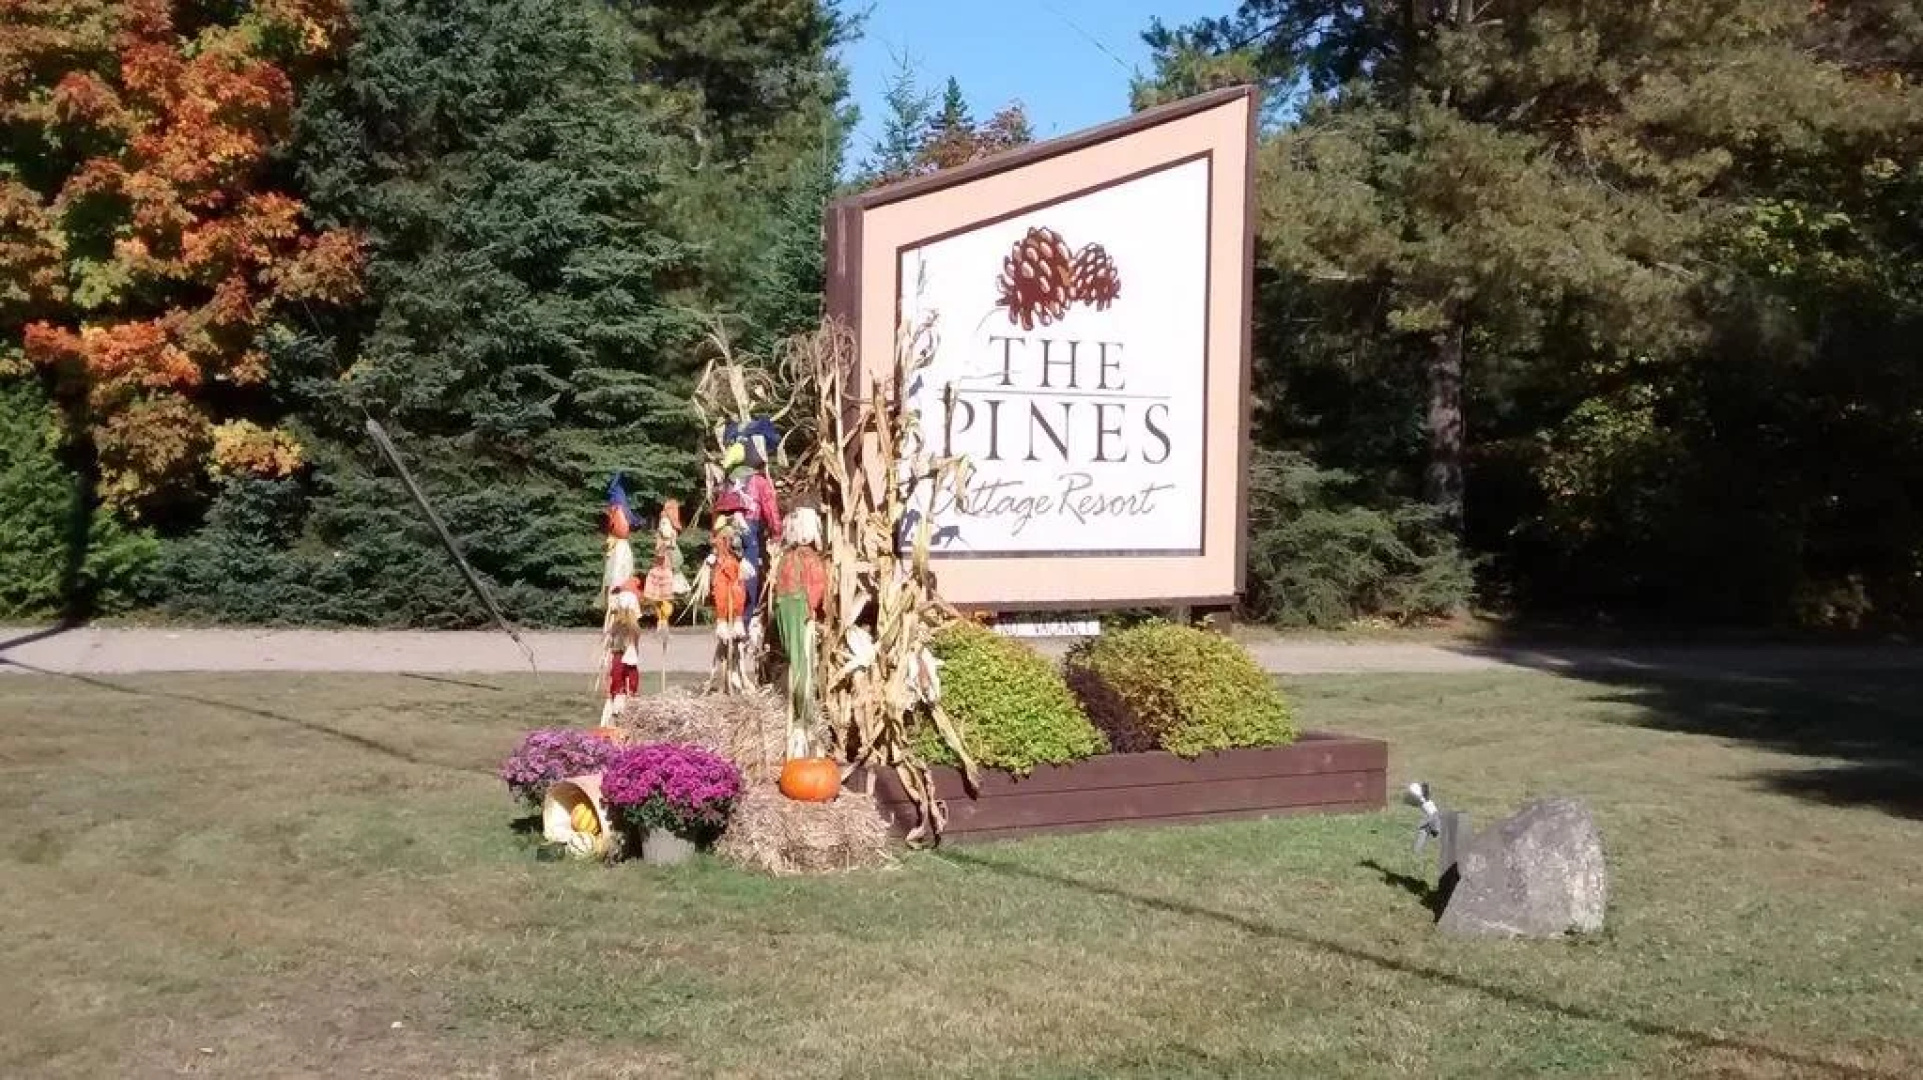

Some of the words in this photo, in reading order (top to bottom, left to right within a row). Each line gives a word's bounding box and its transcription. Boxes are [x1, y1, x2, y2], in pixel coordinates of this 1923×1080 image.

[989, 335, 1126, 391] THE
[938, 397, 1173, 465] PINES
[1056, 472, 1176, 525] Resort
